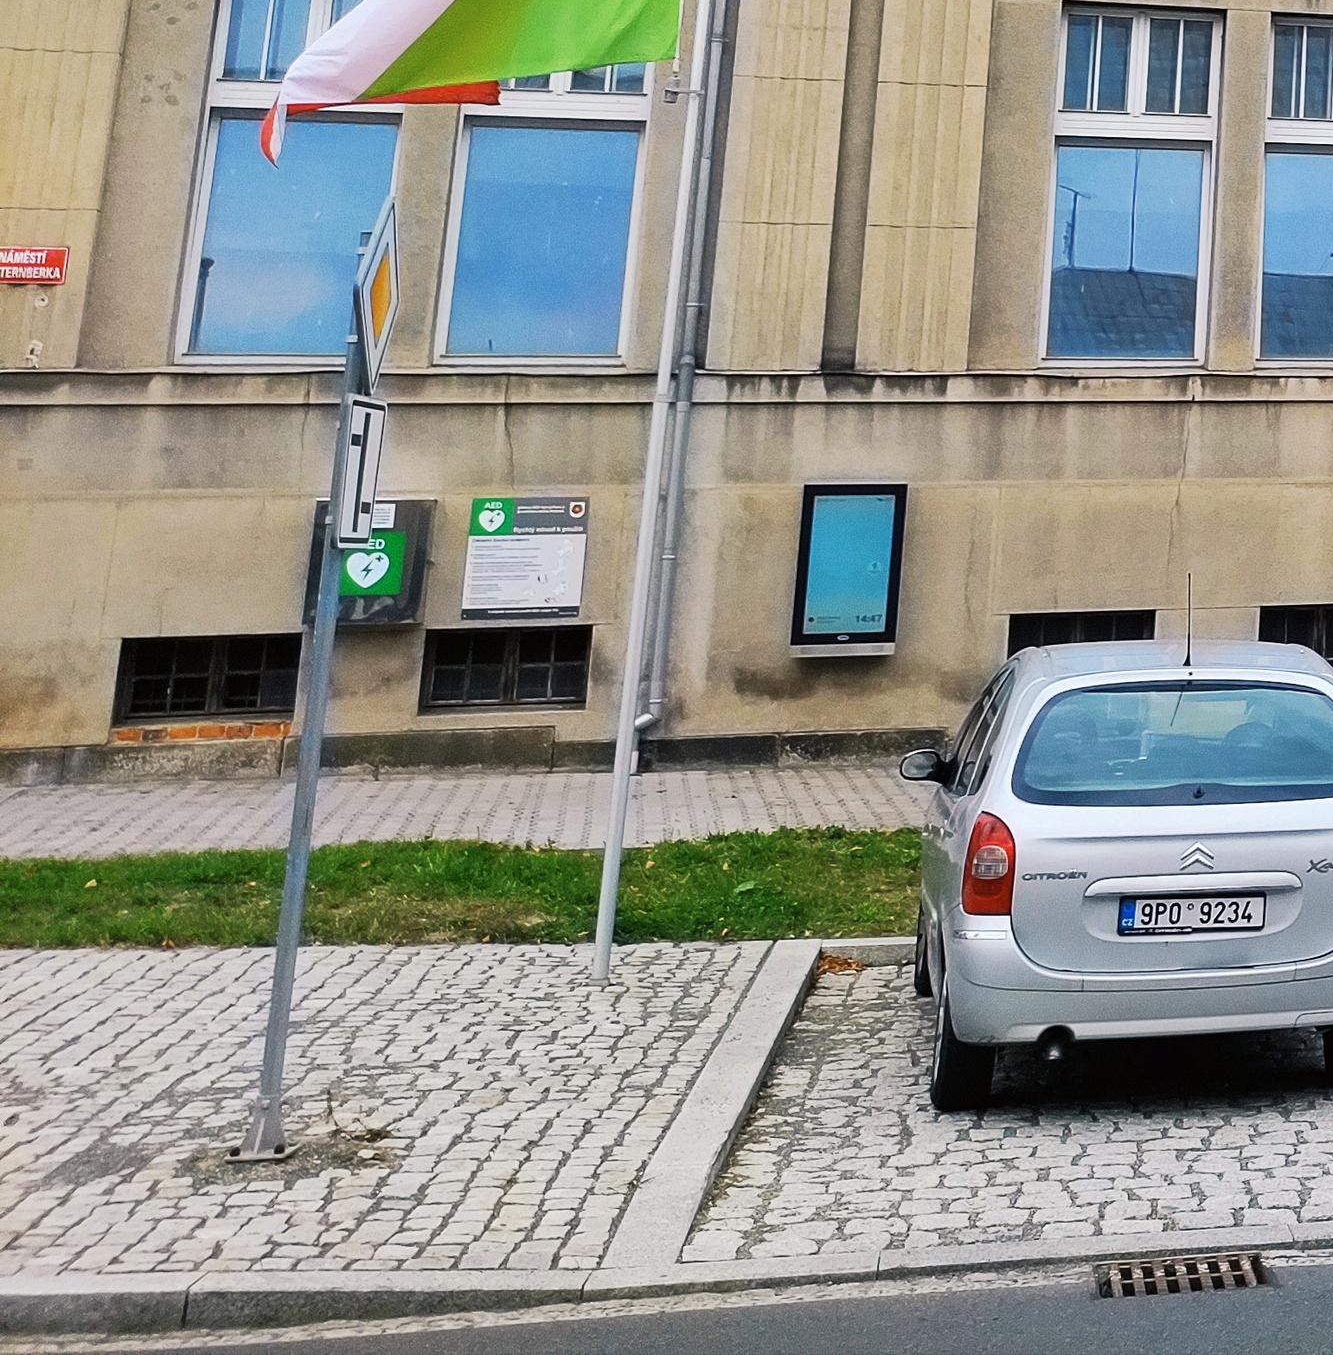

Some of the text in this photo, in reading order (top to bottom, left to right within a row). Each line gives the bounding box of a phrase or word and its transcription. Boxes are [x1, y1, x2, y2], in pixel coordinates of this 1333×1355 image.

[0, 249, 48, 264] NÁMĚSTÍ
[0, 266, 61, 279] TERNBERKA
[484, 501, 503, 509] AED
[368, 538, 386, 550] ED
[1121, 901, 1253, 927] CZ 9P0 9234
